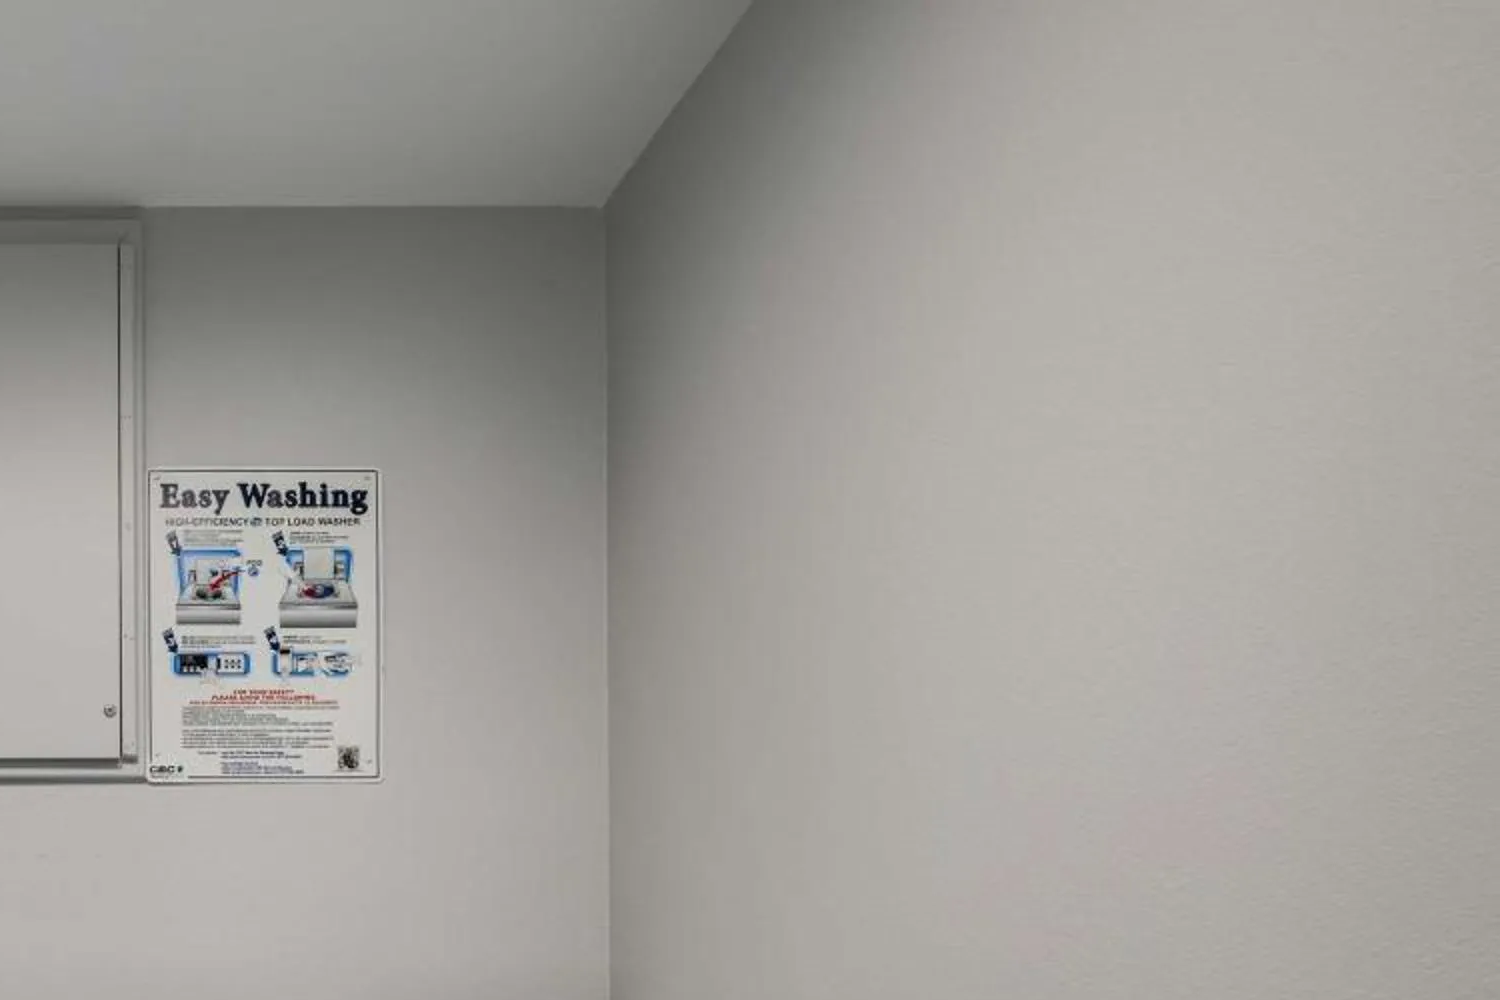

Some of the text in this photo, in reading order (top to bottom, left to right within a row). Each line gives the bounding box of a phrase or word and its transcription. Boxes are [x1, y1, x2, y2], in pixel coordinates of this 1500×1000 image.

[160, 481, 369, 515] Easy Washing
[287, 517, 315, 526] LOAD
[318, 517, 361, 526] WASHER
